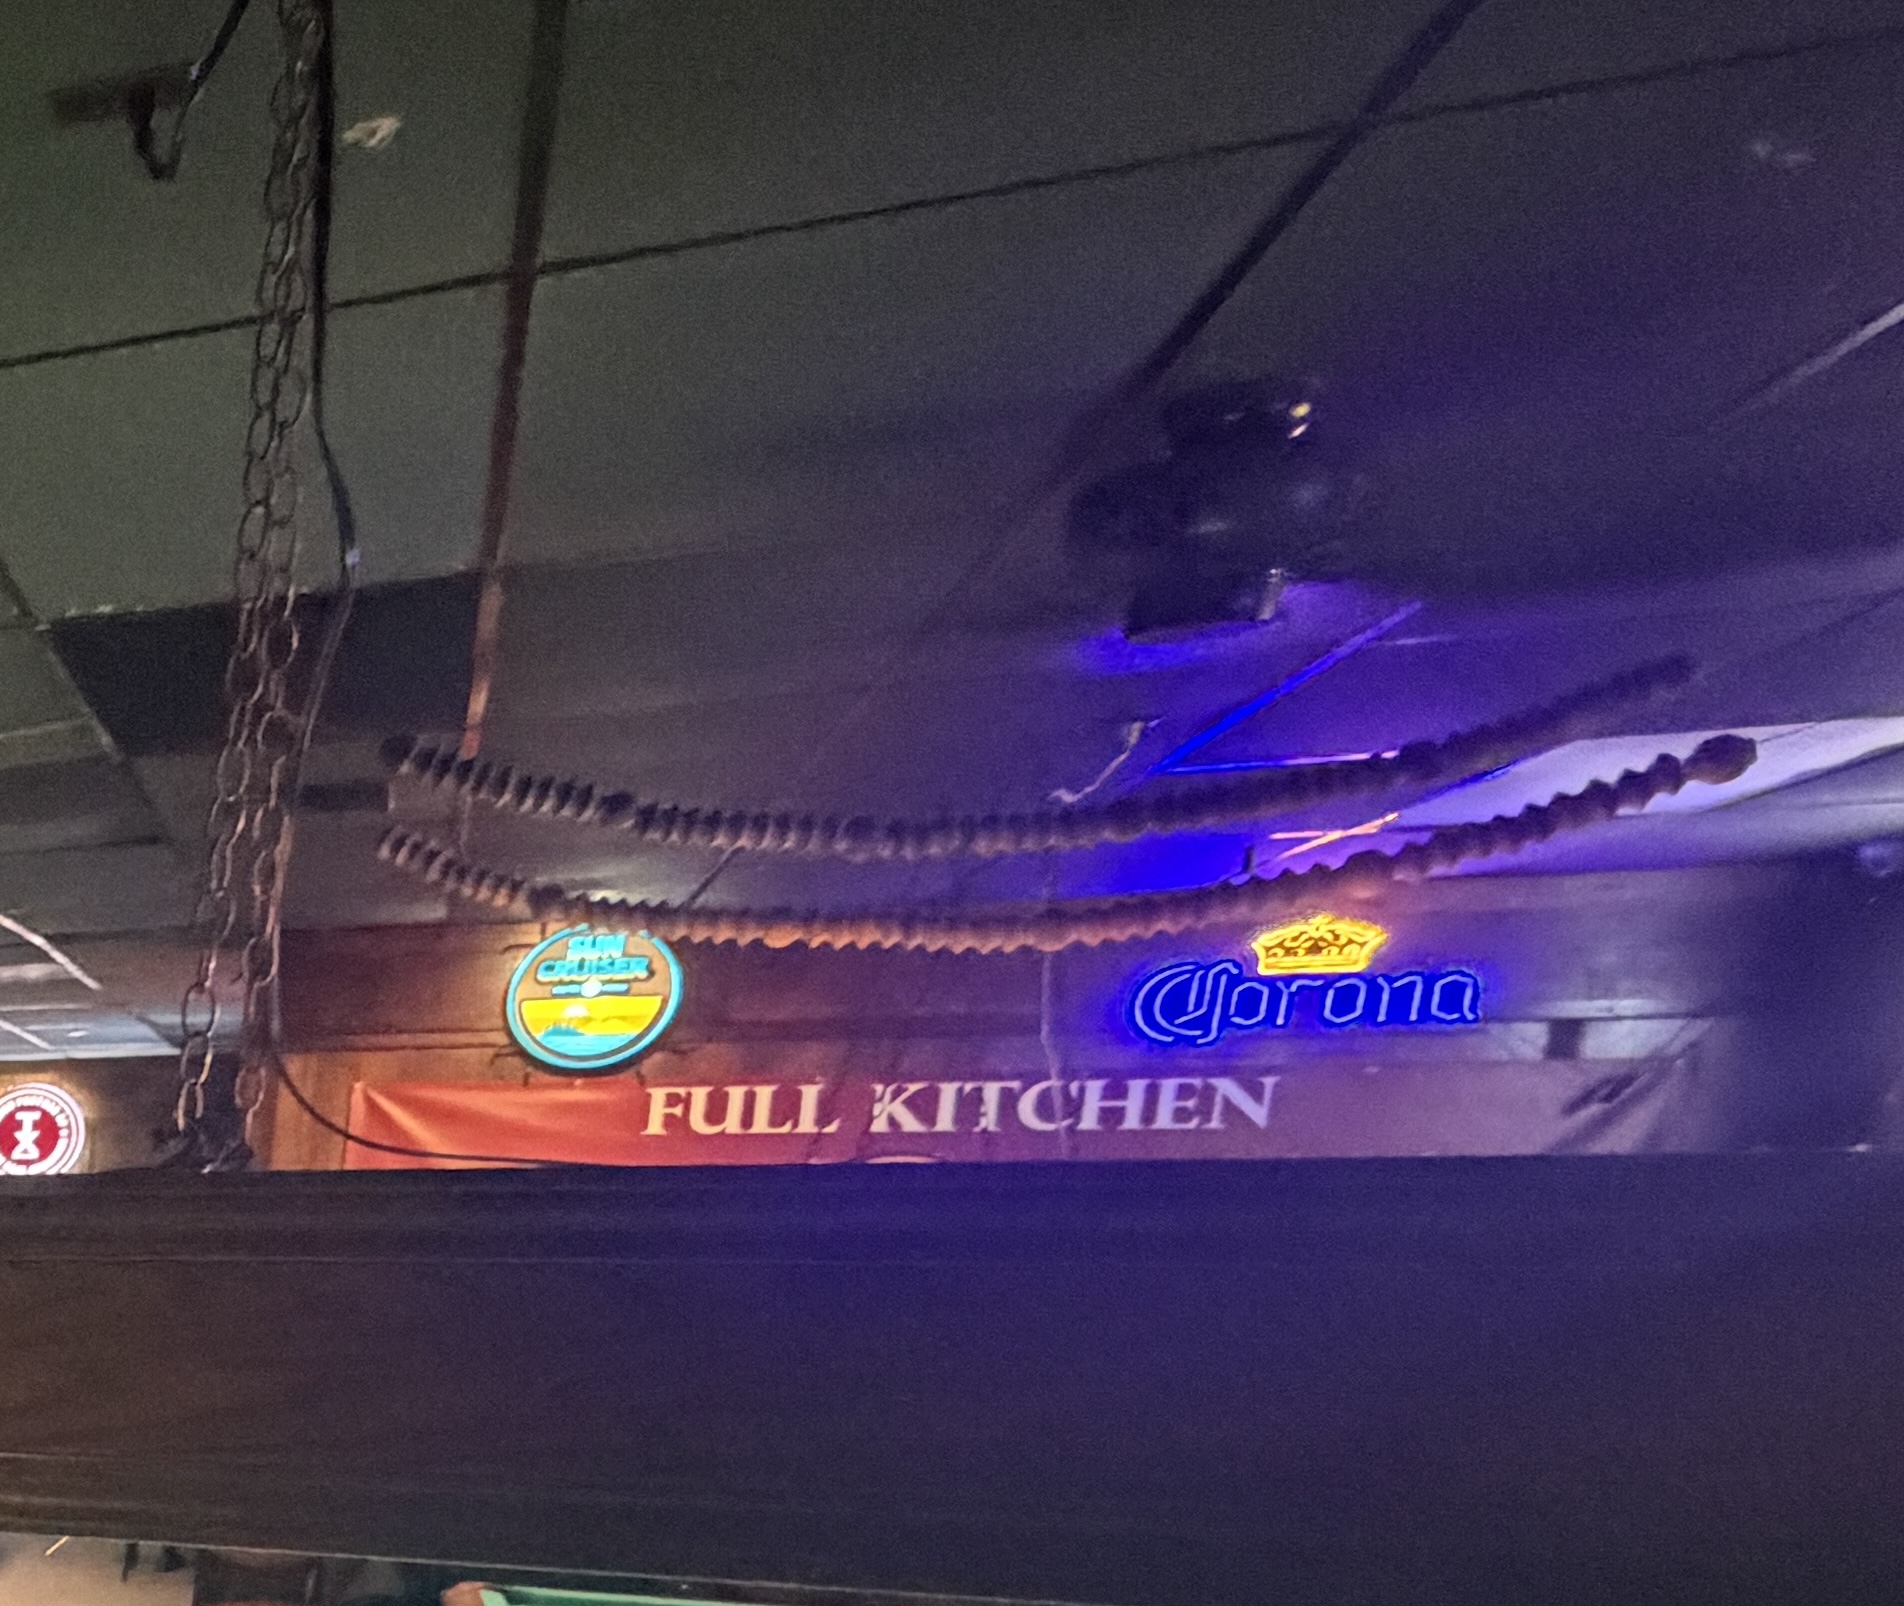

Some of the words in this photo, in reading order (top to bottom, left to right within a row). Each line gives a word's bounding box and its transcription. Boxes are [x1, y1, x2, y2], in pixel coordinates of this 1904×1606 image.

[567, 934, 627, 960] SUN
[536, 957, 652, 983] CRUISER
[1134, 961, 1481, 1045] Corona
[640, 1082, 840, 1136] FULL
[868, 1076, 1281, 1135] KITCHEN
